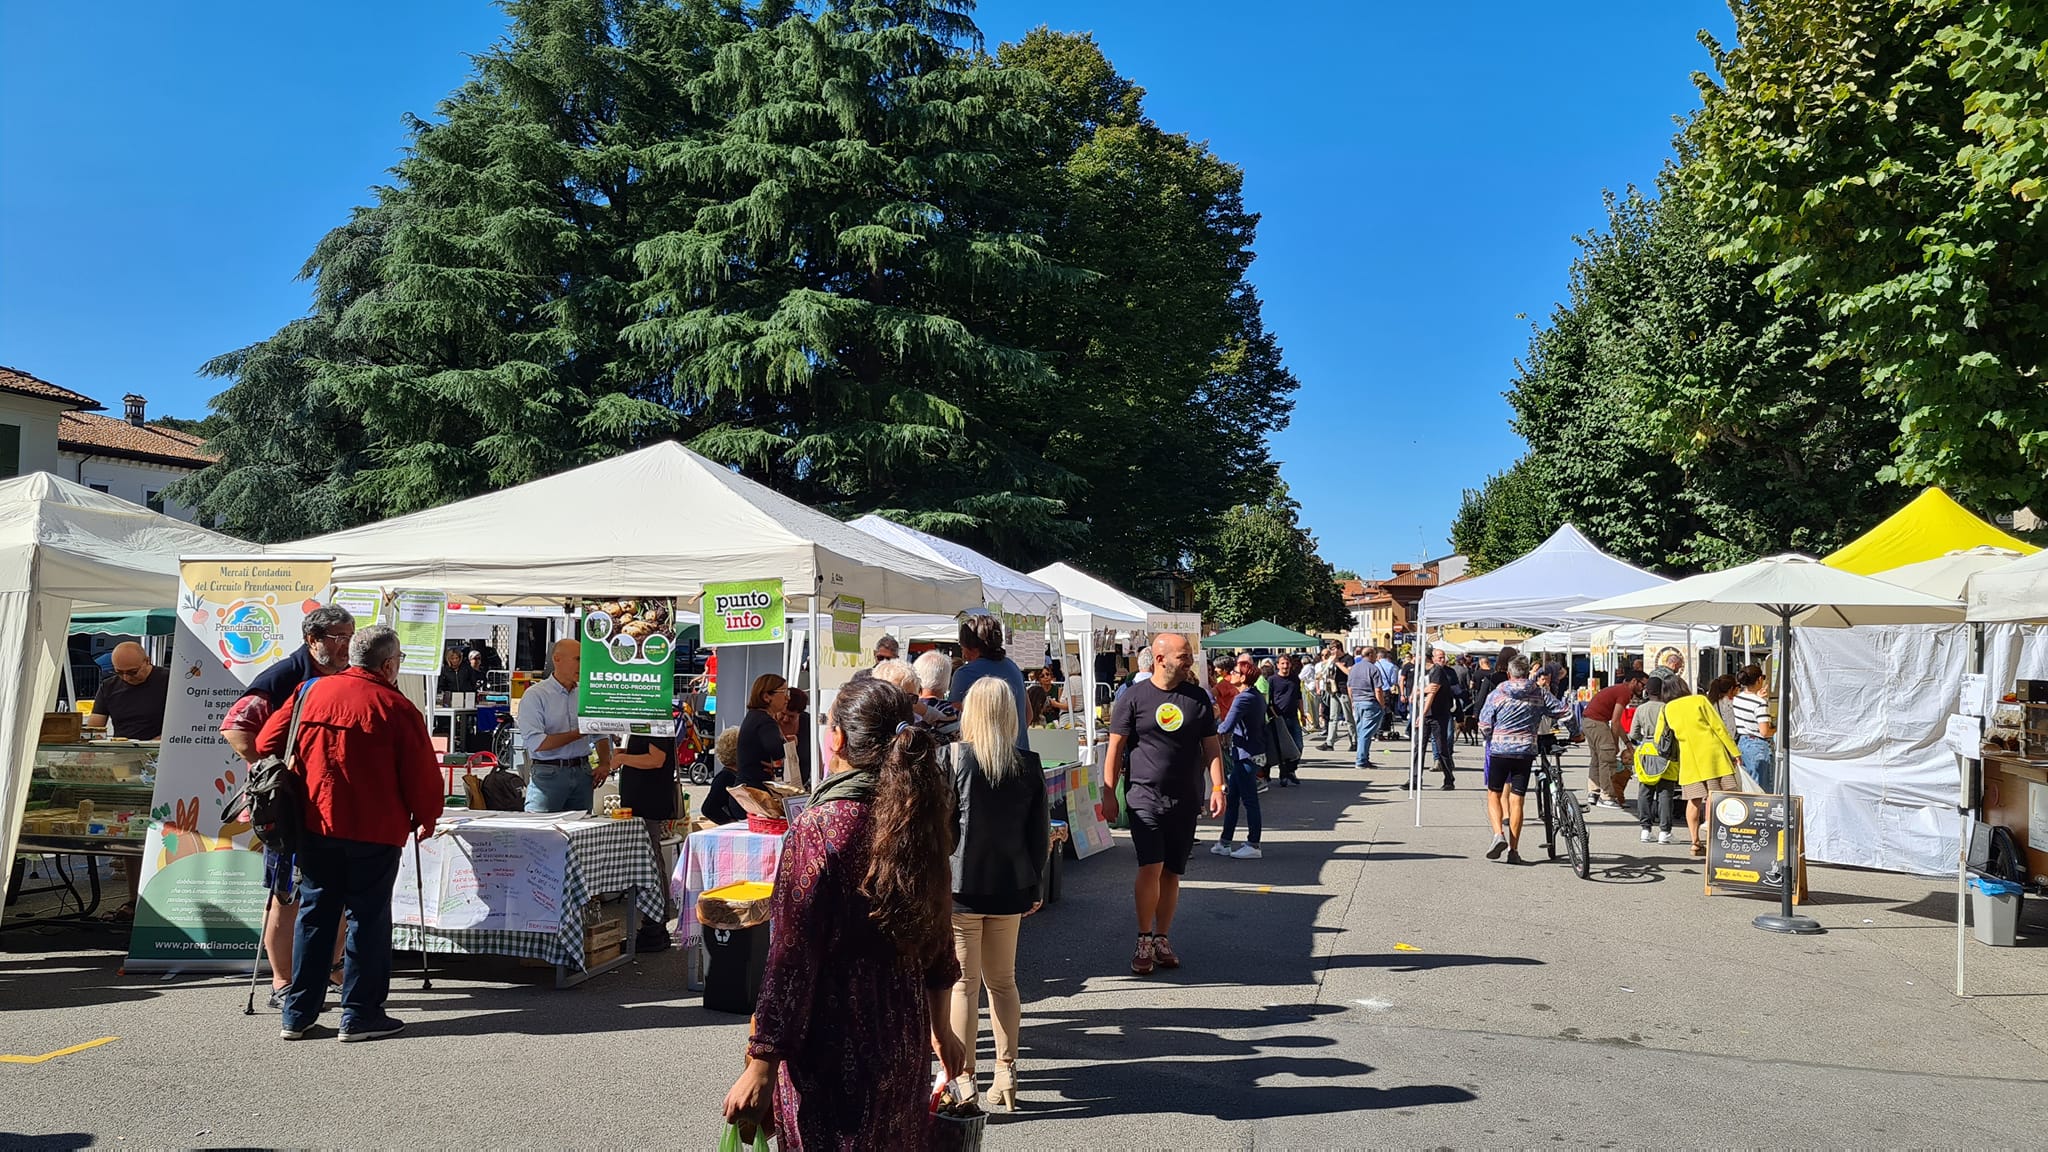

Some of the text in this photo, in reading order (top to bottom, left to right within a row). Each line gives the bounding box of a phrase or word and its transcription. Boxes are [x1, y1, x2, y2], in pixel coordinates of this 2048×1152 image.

[220, 566, 292, 577] Mercati Contadini
[195, 580, 314, 592] del Circuito Prendiamoci Cura
[716, 591, 770, 613] punto
[726, 611, 762, 629] info
[215, 623, 271, 632] Prendiamoci
[262, 632, 284, 641] Cura
[590, 672, 661, 683] LE SOLIDALI
[590, 682, 620, 690] BIOPATATE
[186, 686, 245, 698] Ogni settima
[204, 700, 212, 708] la
[192, 724, 206, 732] nei
[169, 736, 230, 744] delle città de
[155, 940, 267, 951] www.prendiamocicu
